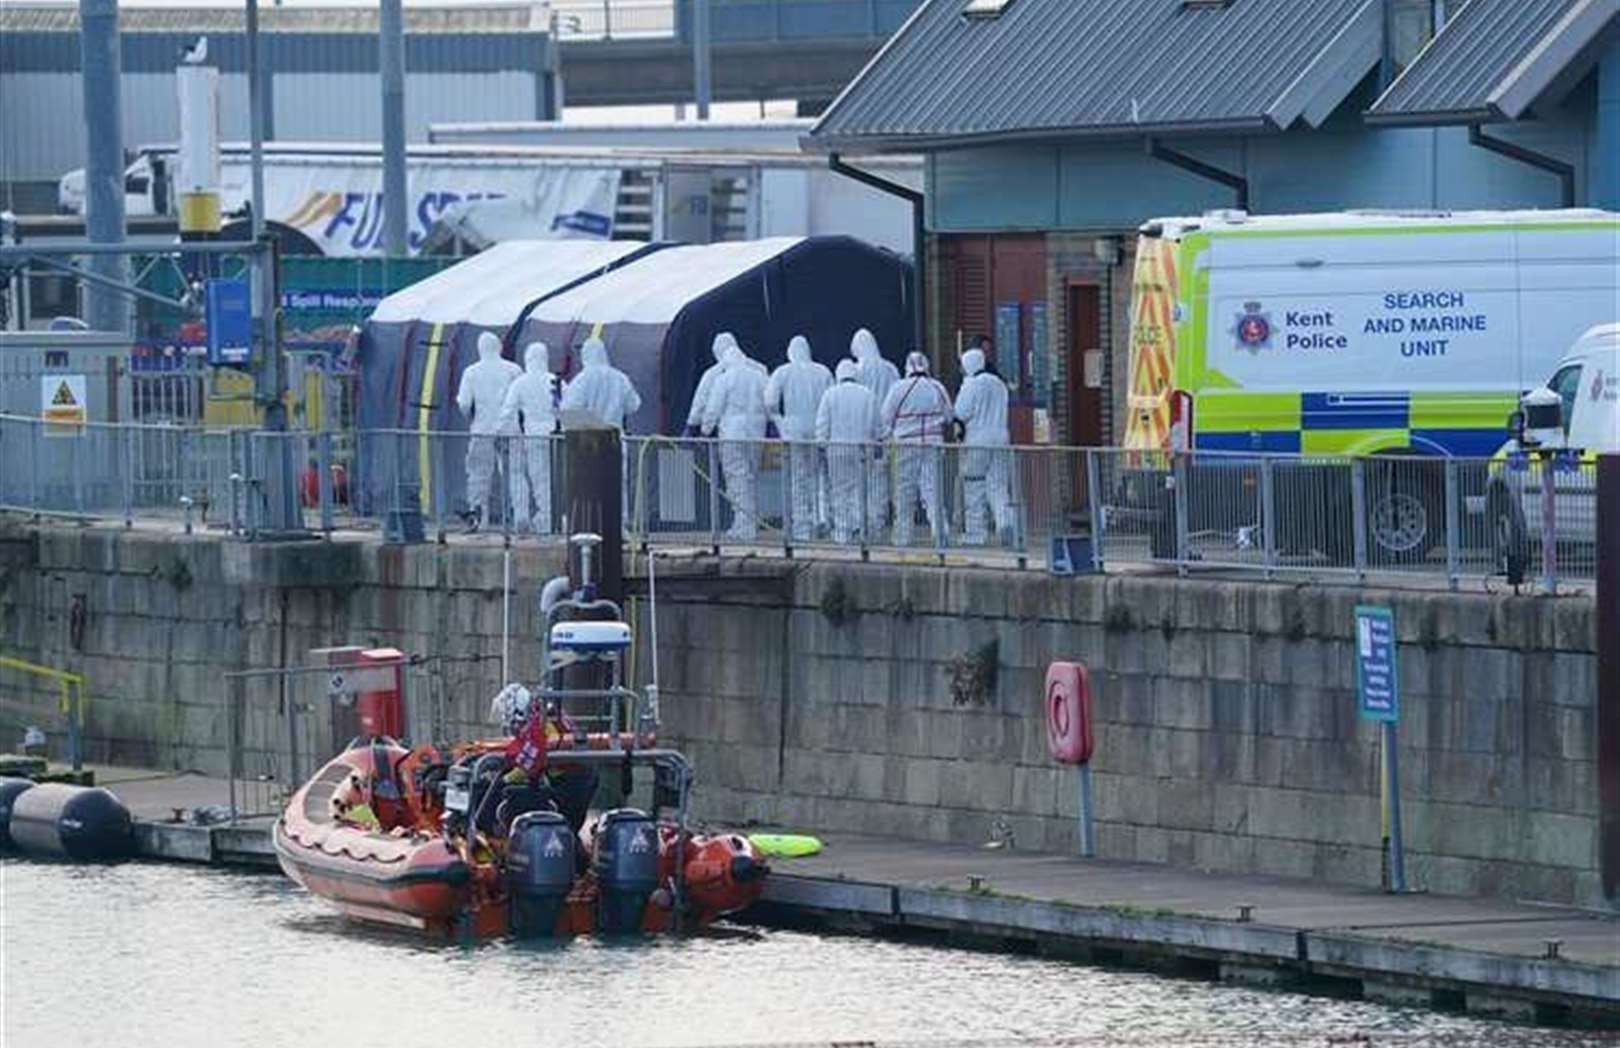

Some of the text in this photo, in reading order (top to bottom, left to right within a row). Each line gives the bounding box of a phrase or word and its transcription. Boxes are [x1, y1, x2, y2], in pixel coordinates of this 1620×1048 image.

[1384, 292, 1464, 309] SEARCH
[1285, 311, 1334, 327] Kent
[1363, 314, 1487, 333] AND MARINE
[1286, 333, 1348, 350] Police
[1400, 339, 1449, 357] UNIT
